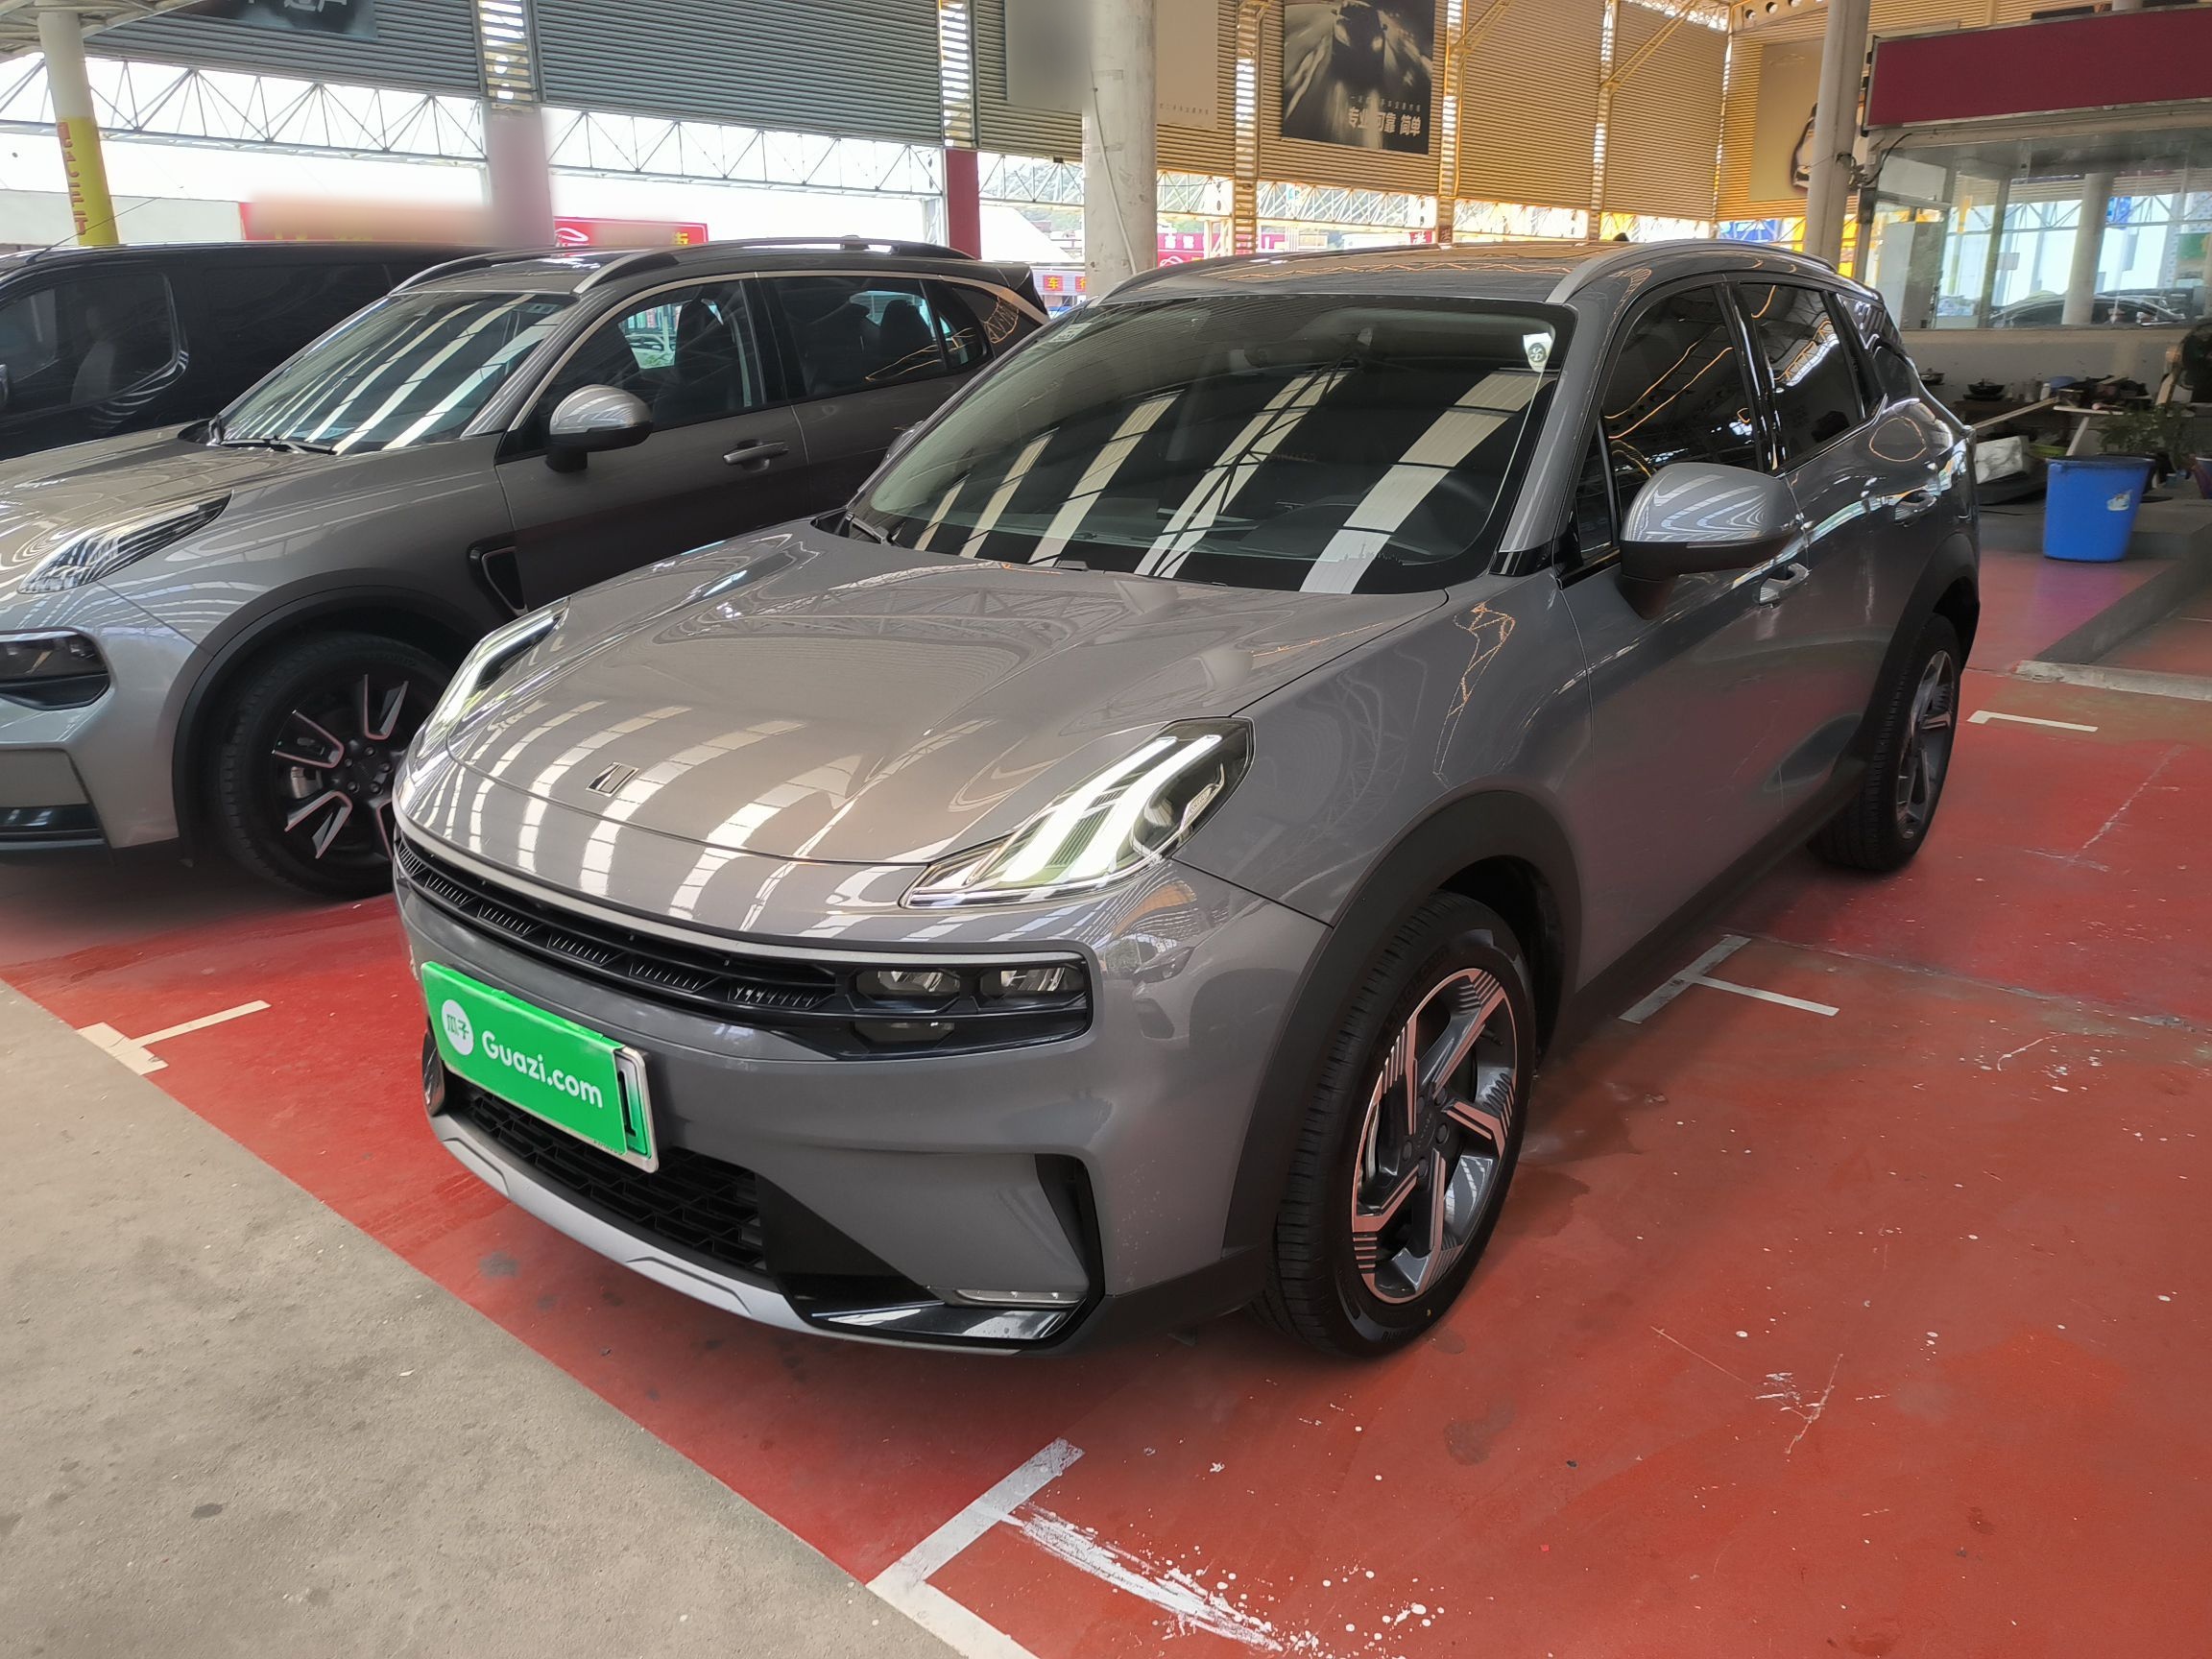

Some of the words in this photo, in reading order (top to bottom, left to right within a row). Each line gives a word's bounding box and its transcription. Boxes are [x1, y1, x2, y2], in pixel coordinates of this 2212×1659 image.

[1376, 111, 1397, 133] 可靠
[1400, 114, 1421, 136] 简单
[446, 1014, 469, 1040] 瓜子
[482, 1030, 604, 1109] Guazi.com
